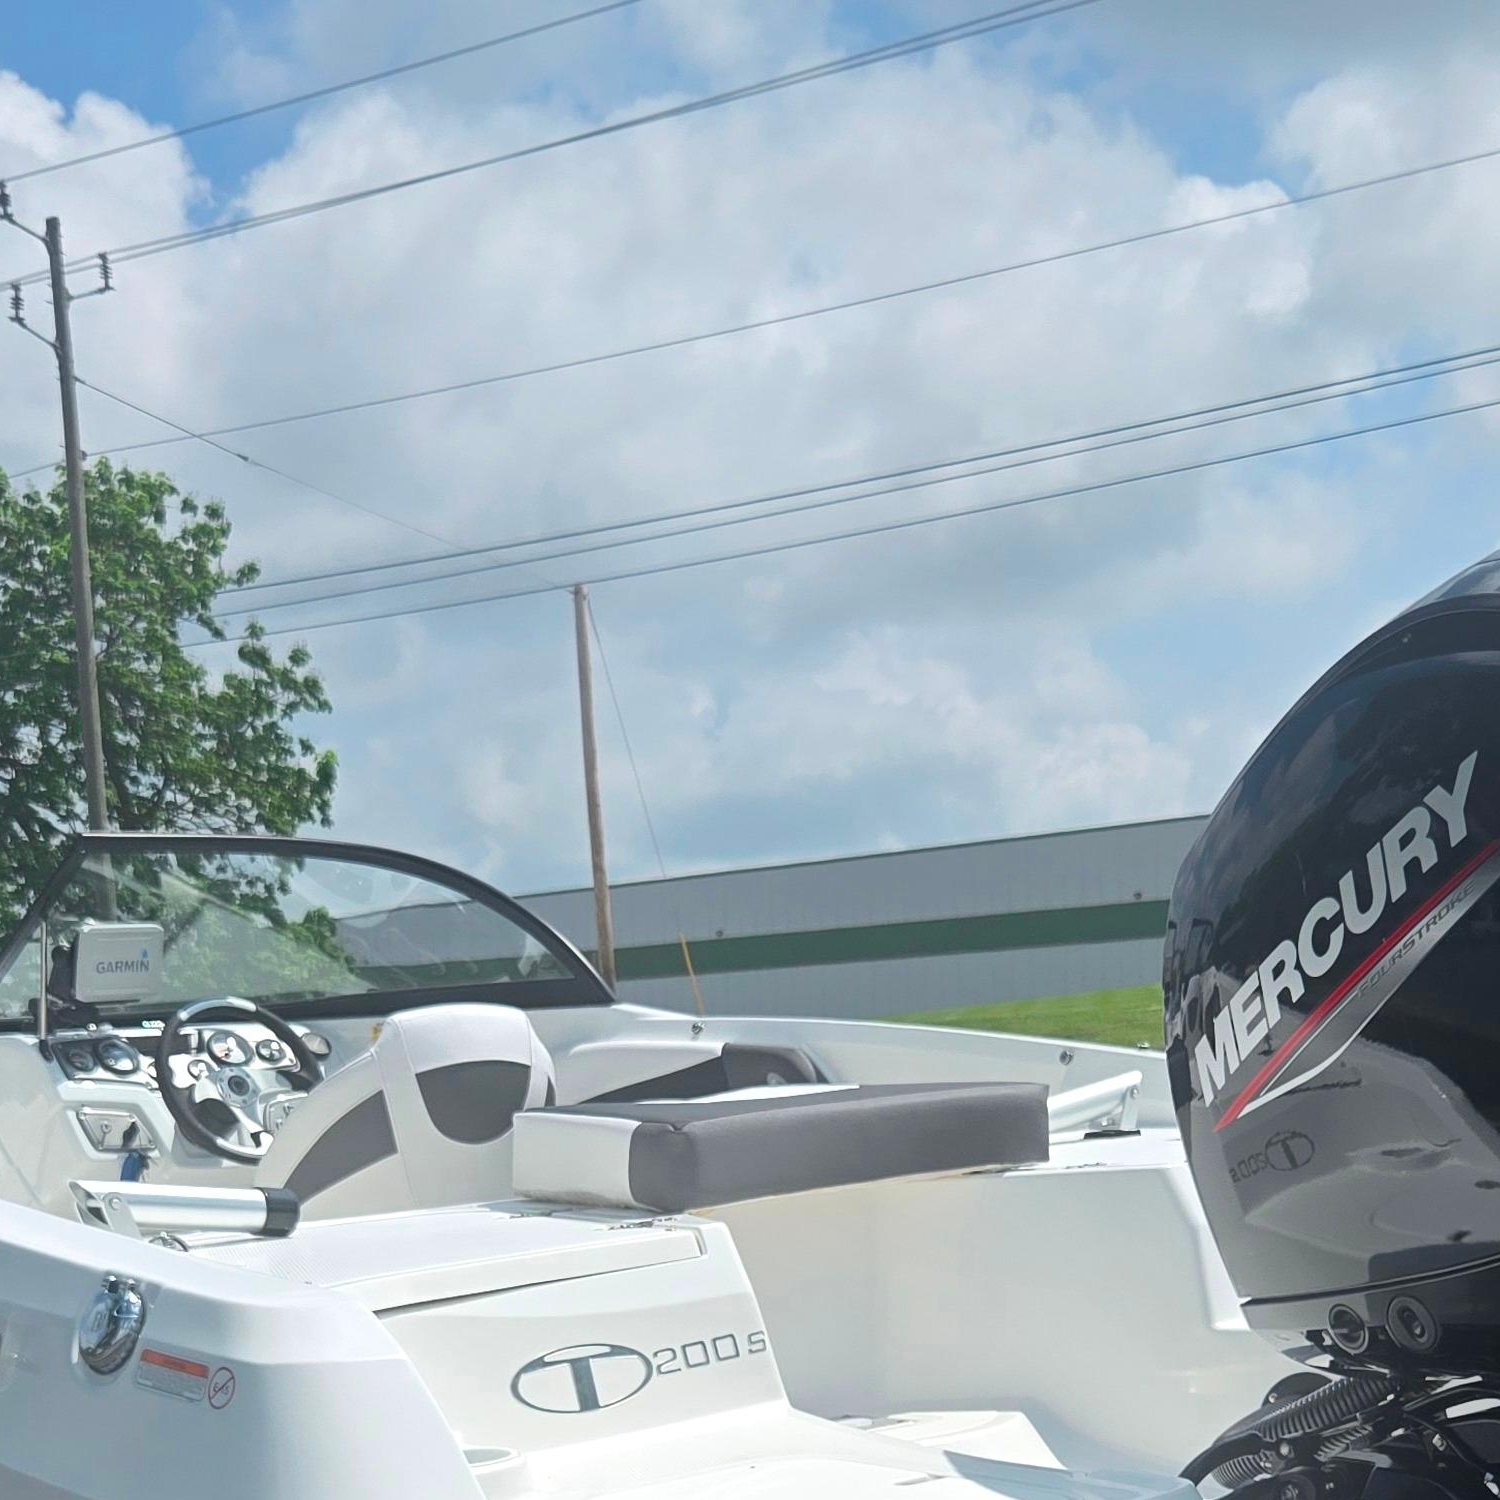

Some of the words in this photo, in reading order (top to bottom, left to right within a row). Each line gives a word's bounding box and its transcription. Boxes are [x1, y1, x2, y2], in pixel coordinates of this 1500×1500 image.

[96, 960, 149, 974] GARMIN
[1195, 750, 1478, 1108] MERCURY
[1357, 880, 1475, 997] FOURSTROKE
